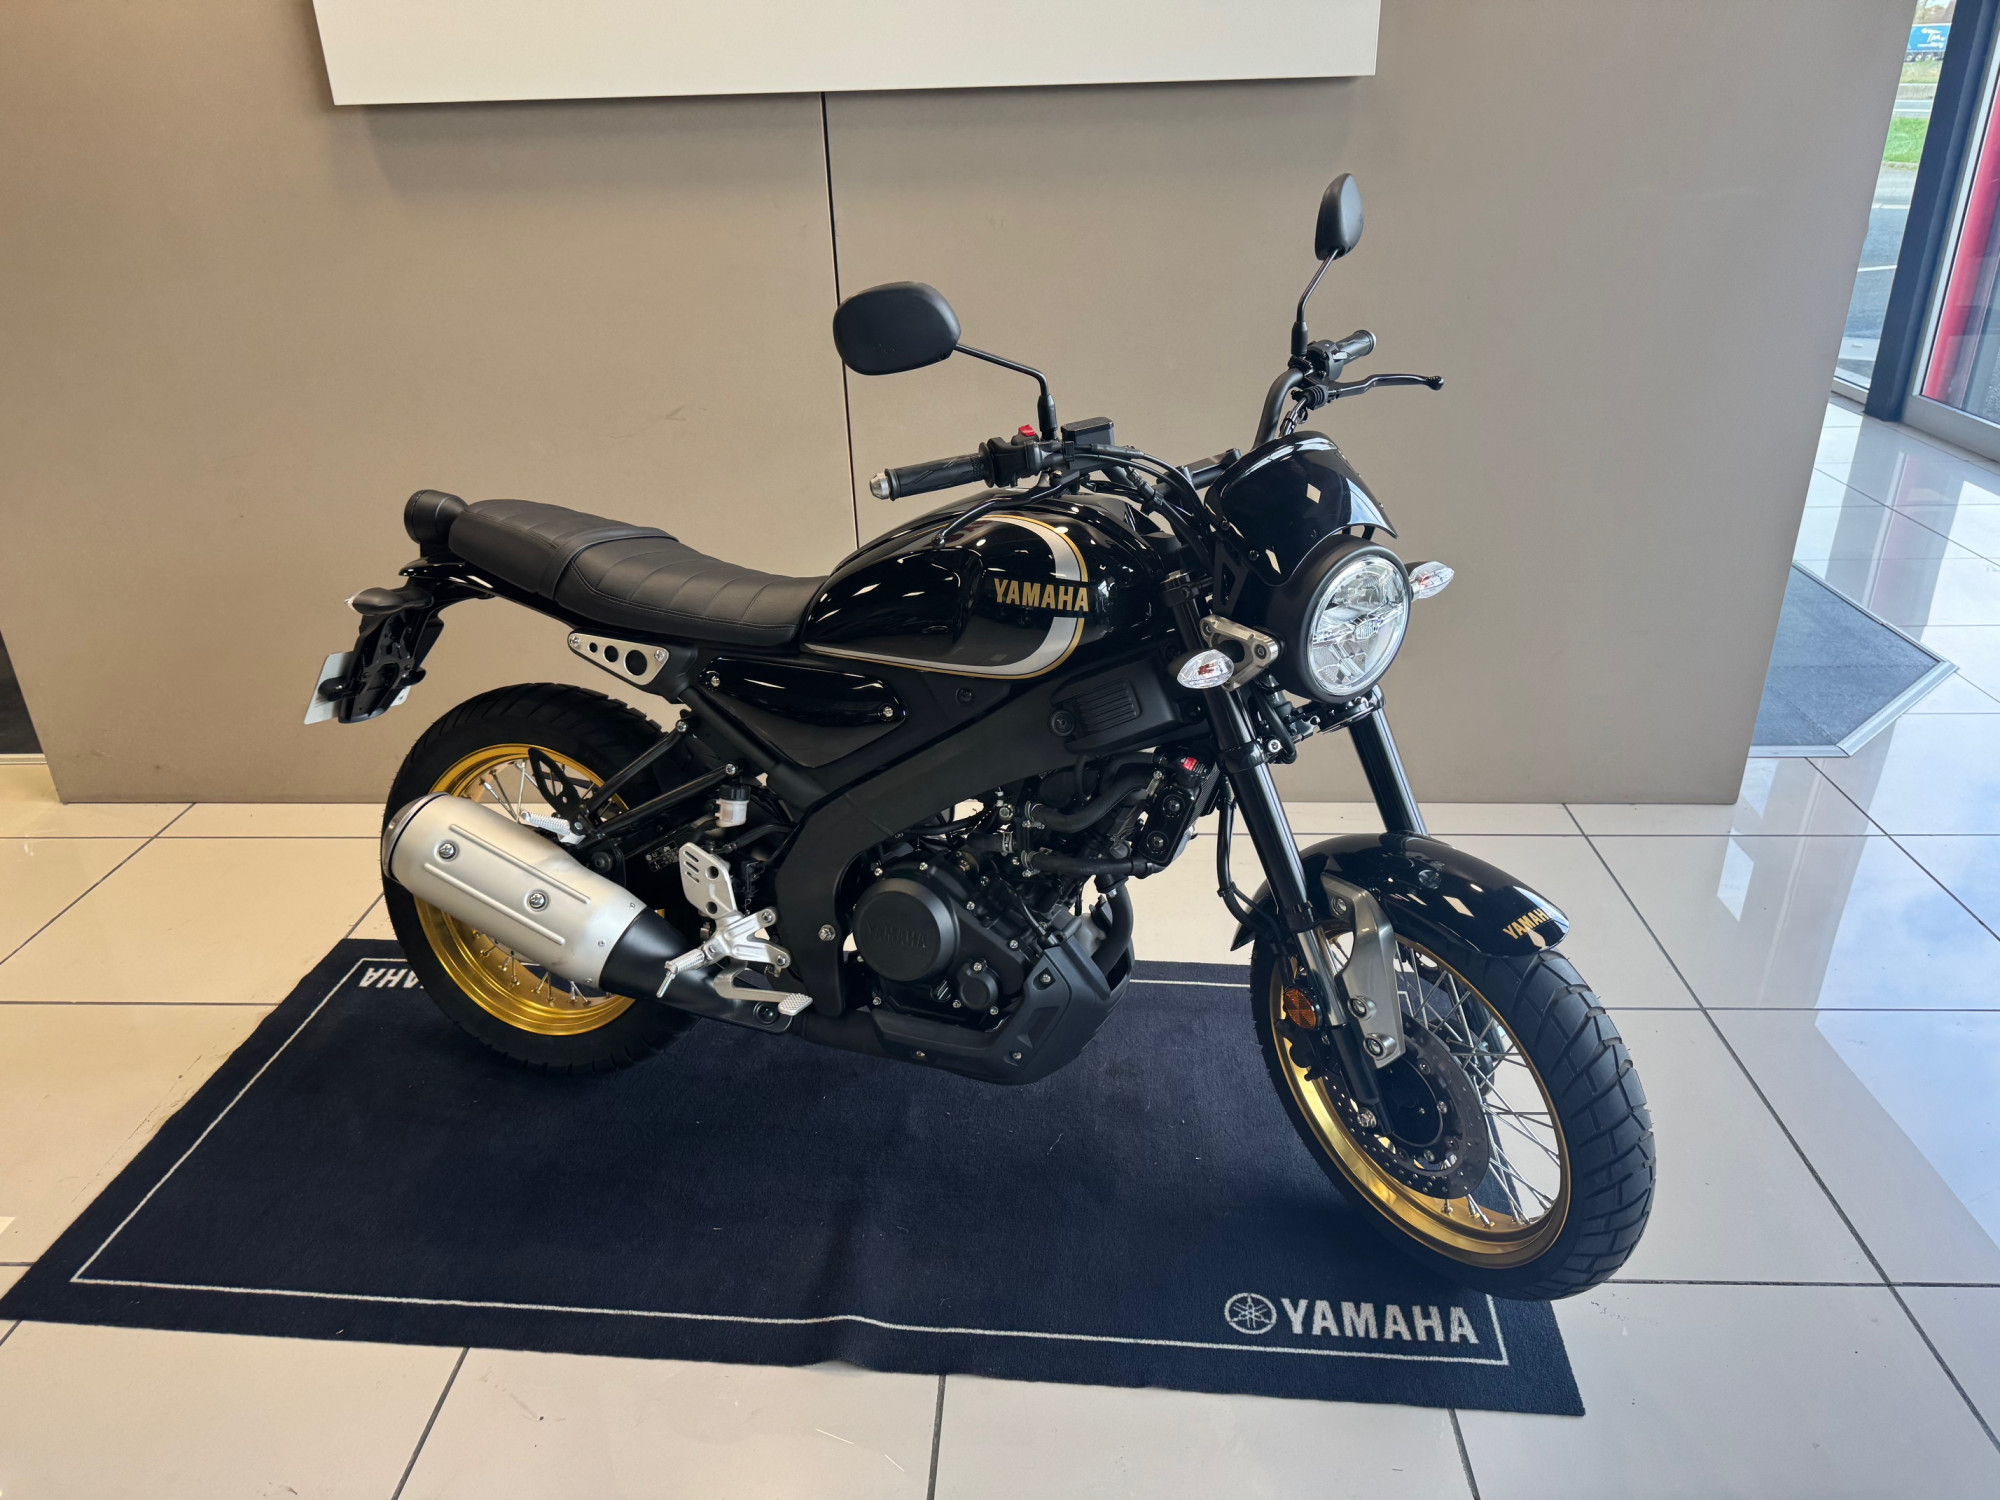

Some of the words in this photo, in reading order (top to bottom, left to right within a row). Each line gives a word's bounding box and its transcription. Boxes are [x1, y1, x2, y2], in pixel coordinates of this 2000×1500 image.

[994, 578, 1089, 612] YAMAHA
[1502, 908, 1550, 939] YAMAH
[1281, 1298, 1479, 1344] YAMAHA
